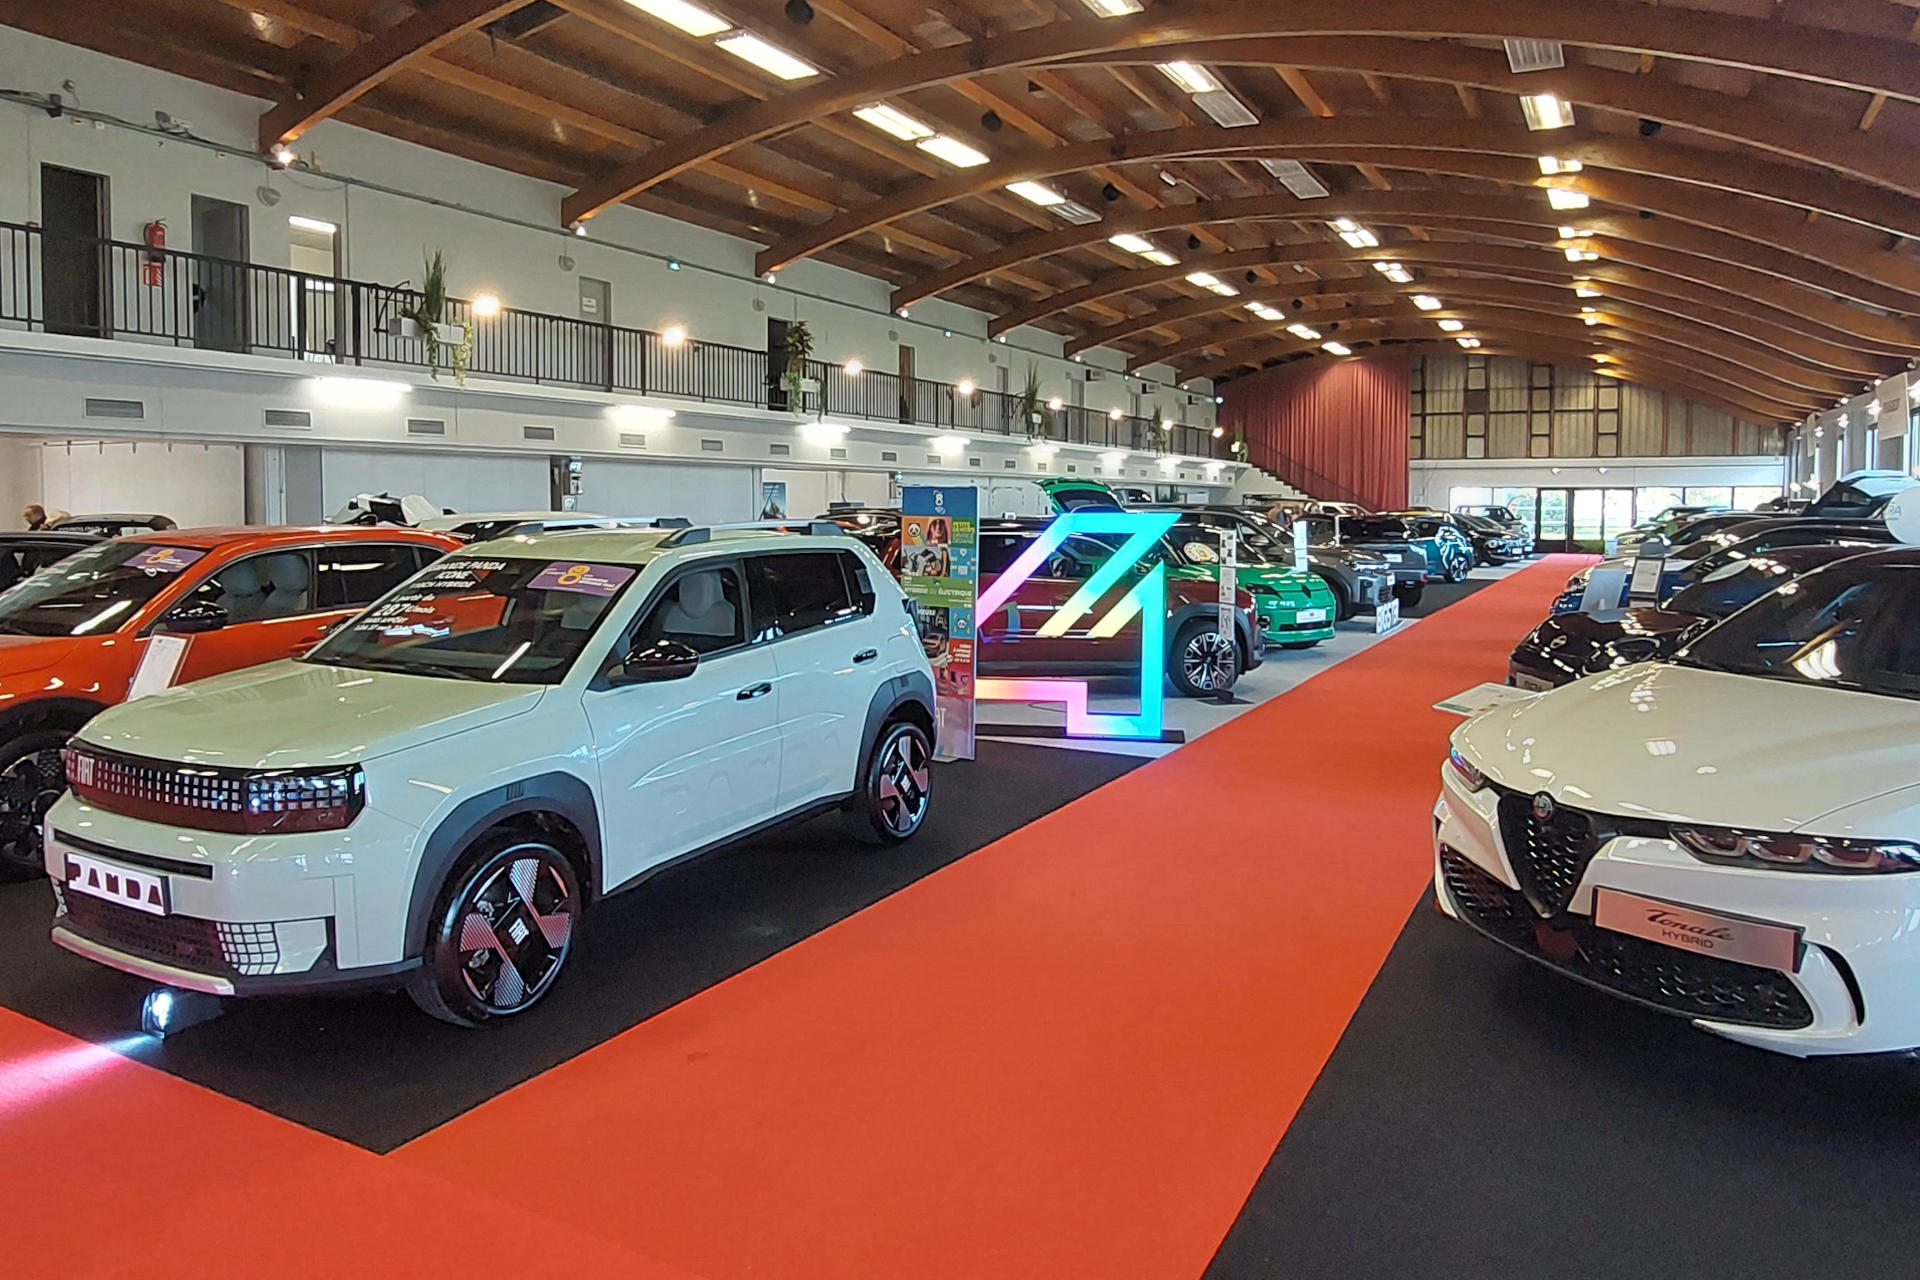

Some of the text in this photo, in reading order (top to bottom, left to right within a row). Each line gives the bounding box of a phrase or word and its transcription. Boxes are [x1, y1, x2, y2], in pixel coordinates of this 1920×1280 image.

[466, 561, 508, 571] PANDA
[77, 755, 95, 786] FIAT
[66, 861, 163, 907] PANDA
[1645, 908, 1735, 941] Tonale
